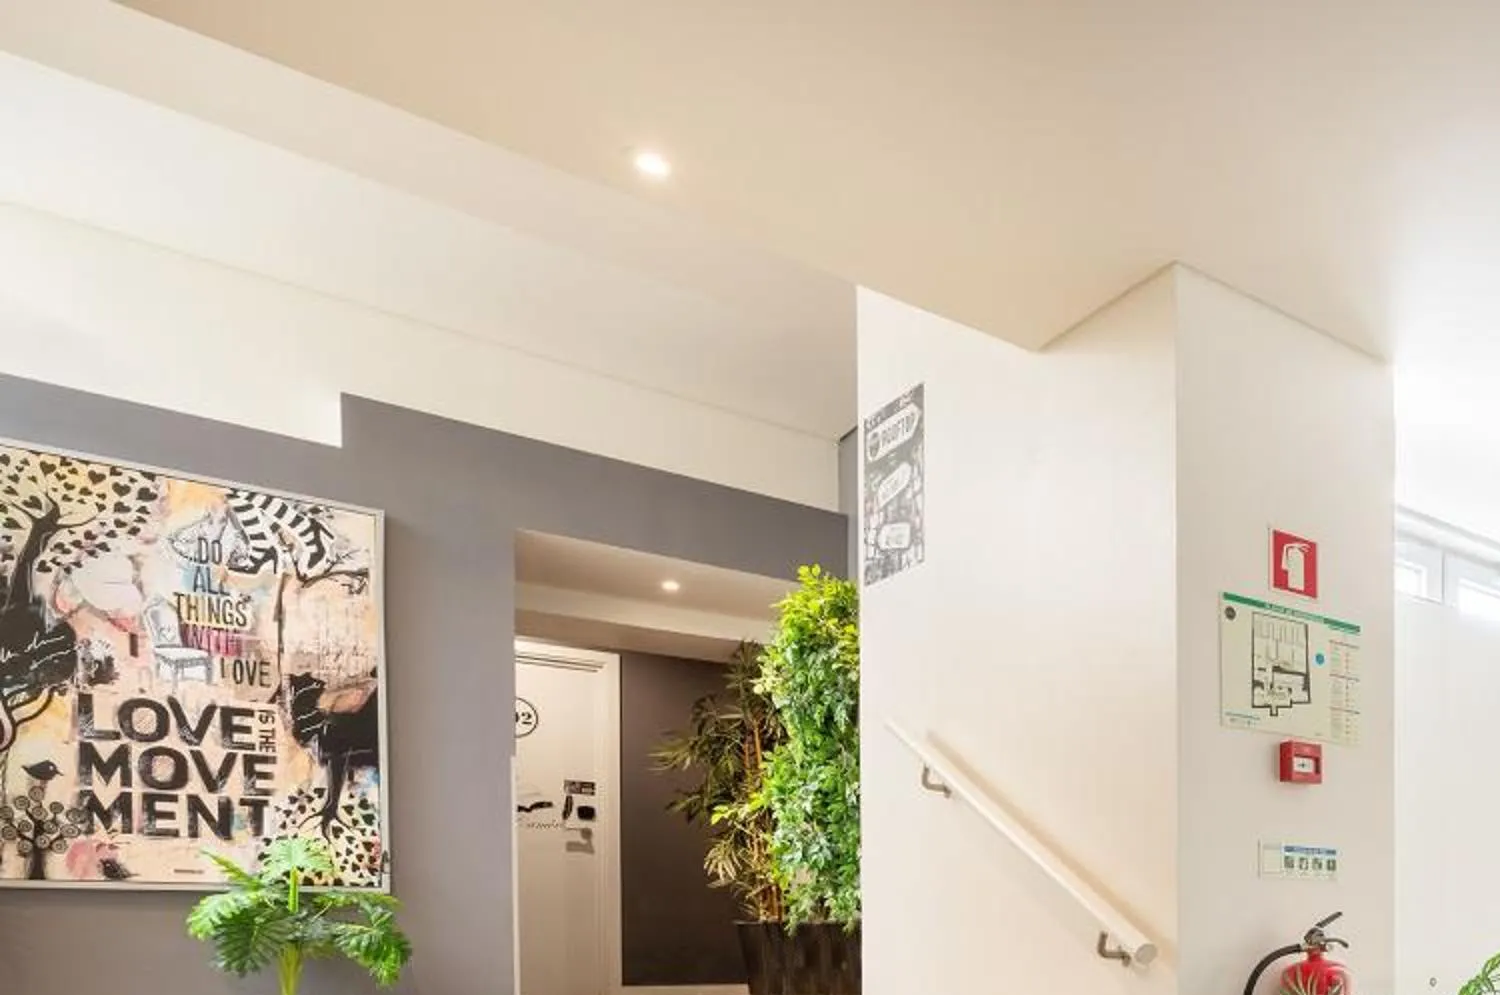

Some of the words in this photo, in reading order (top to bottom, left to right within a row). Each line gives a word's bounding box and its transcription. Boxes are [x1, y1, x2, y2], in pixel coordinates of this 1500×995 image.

[197, 537, 223, 564] DO
[193, 565, 231, 596] ALL
[172, 591, 248, 627] THINGS
[220, 656, 273, 688] LOVE
[77, 692, 257, 752] LOVE
[258, 709, 277, 725] IS
[258, 727, 277, 753] THE
[78, 740, 278, 797] MOVE
[78, 788, 270, 842] MENT
